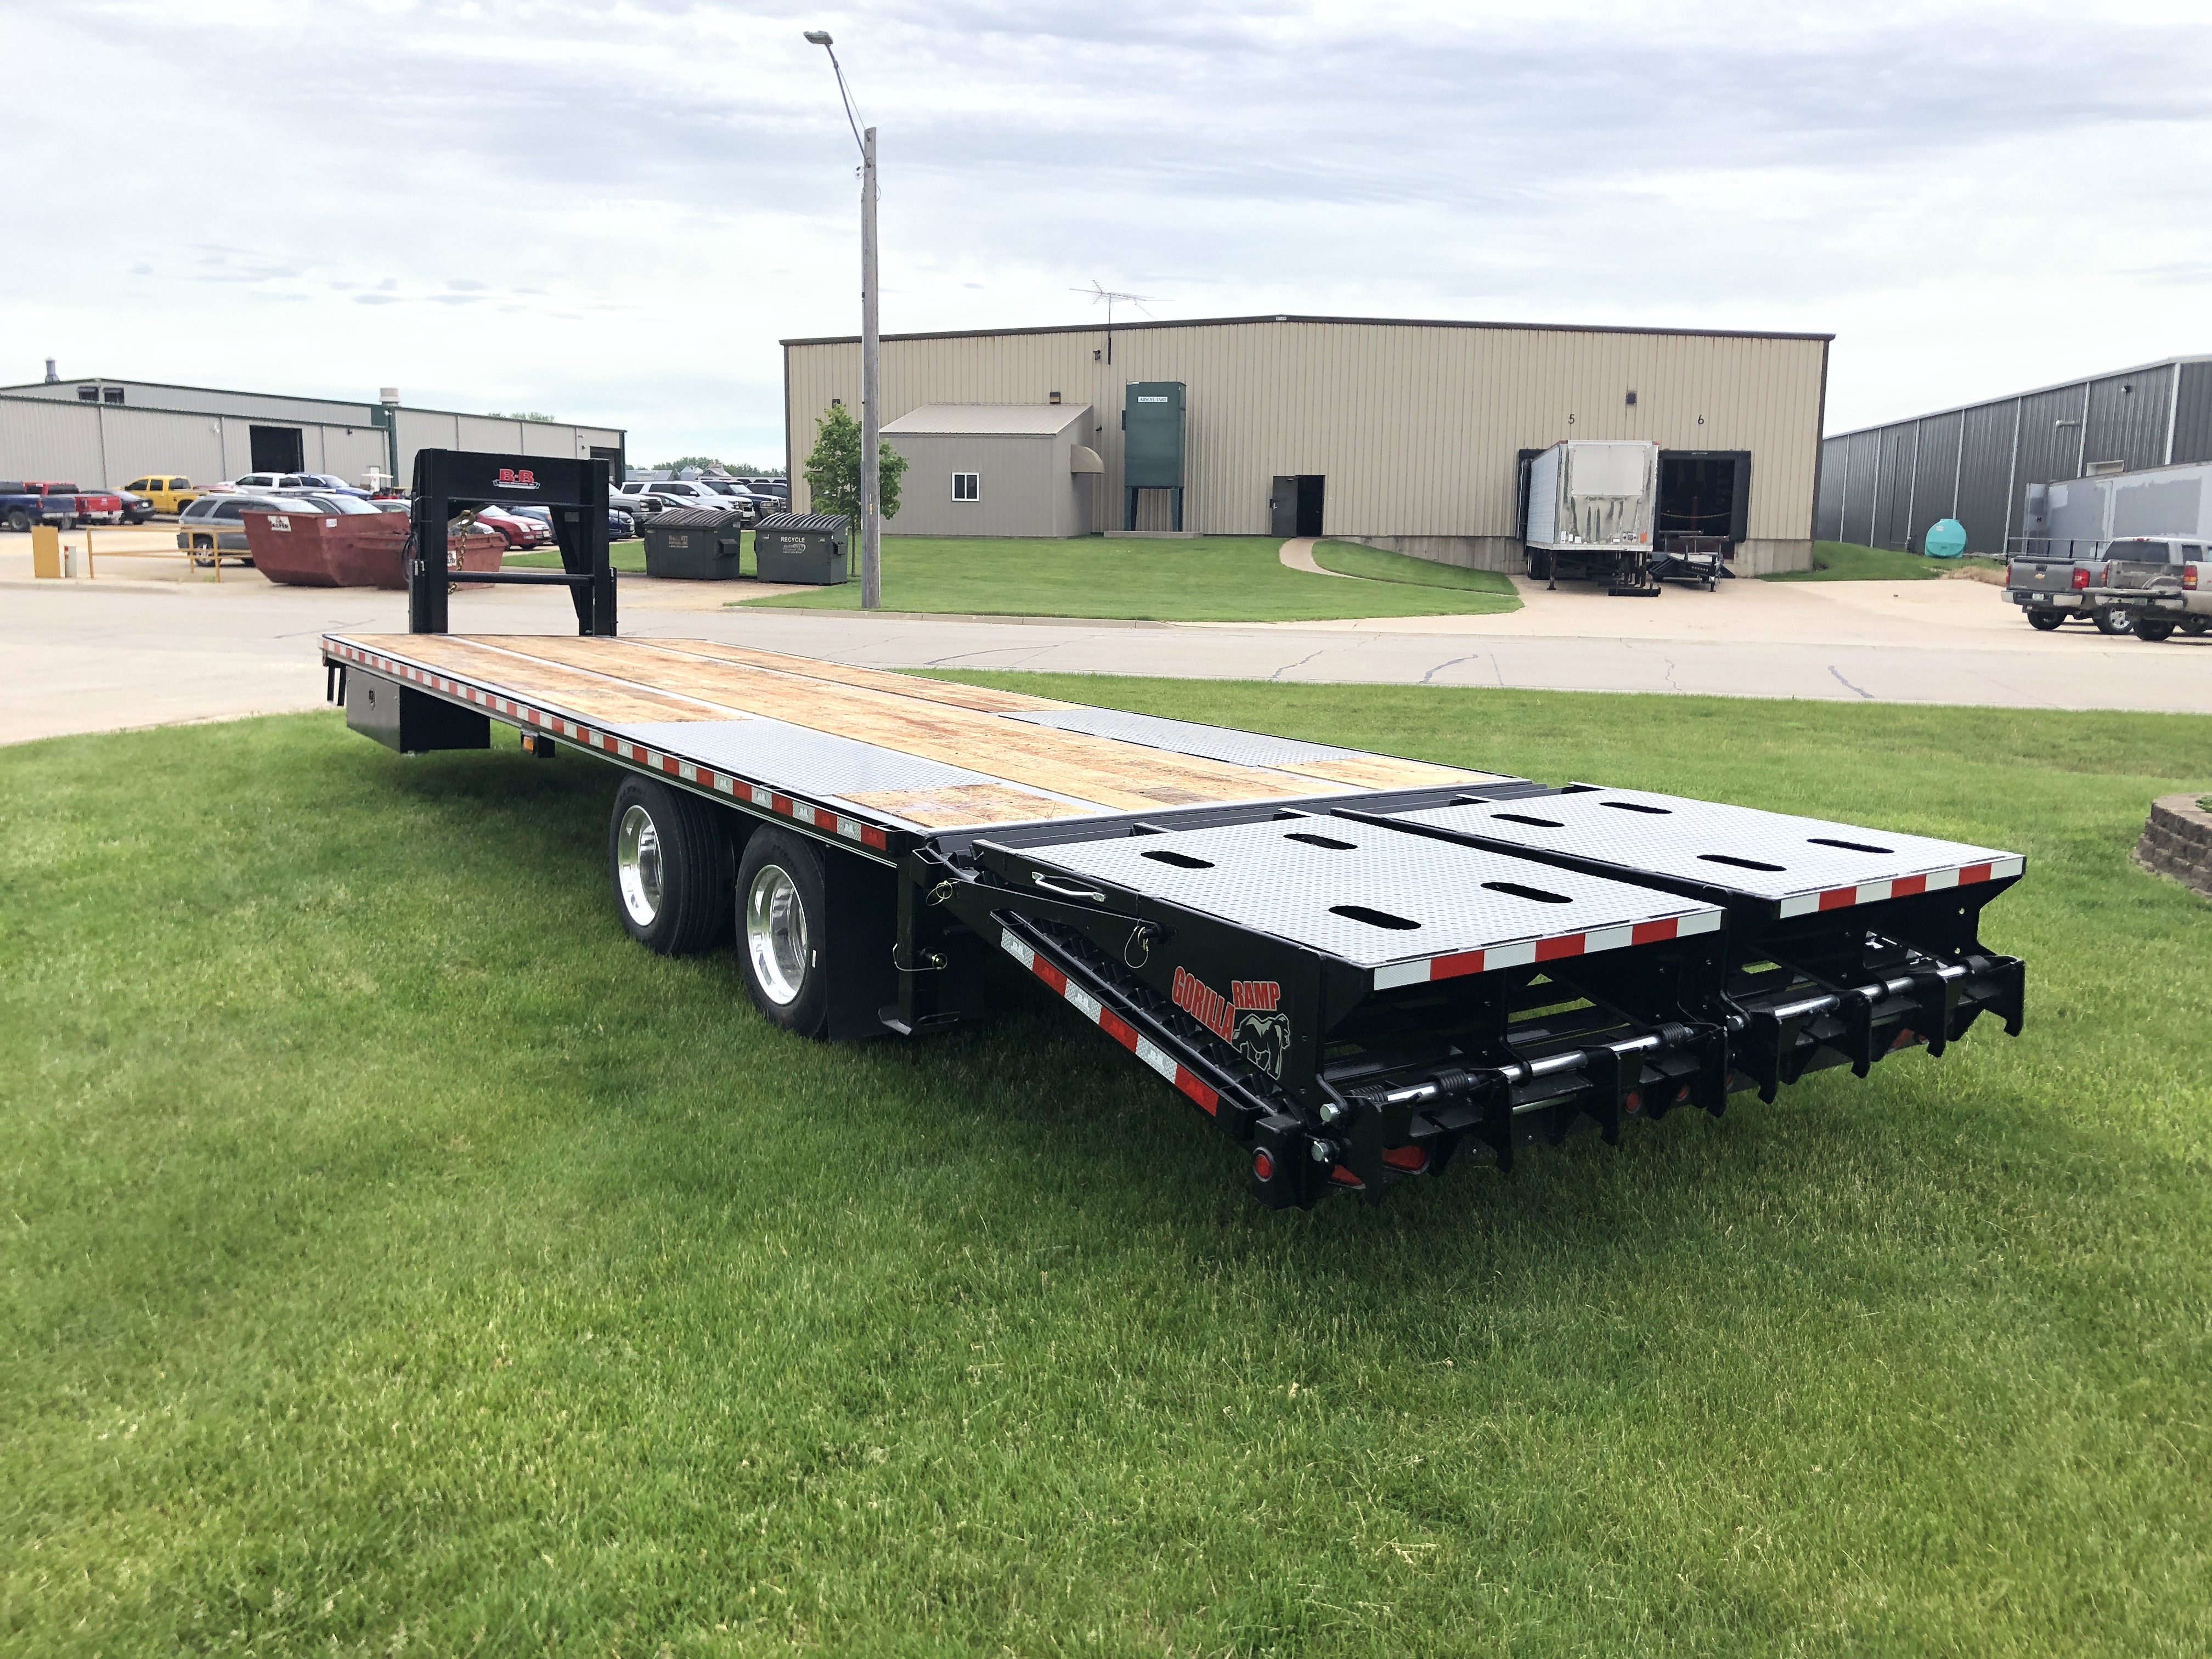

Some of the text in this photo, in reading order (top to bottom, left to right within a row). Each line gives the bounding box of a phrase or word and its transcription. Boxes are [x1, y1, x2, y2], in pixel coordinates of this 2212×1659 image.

[1568, 414, 1575, 425] 5
[1697, 414, 1705, 425] 6
[499, 468, 534, 483] B-B
[1172, 966, 1281, 1045] GORILLA RAMP
